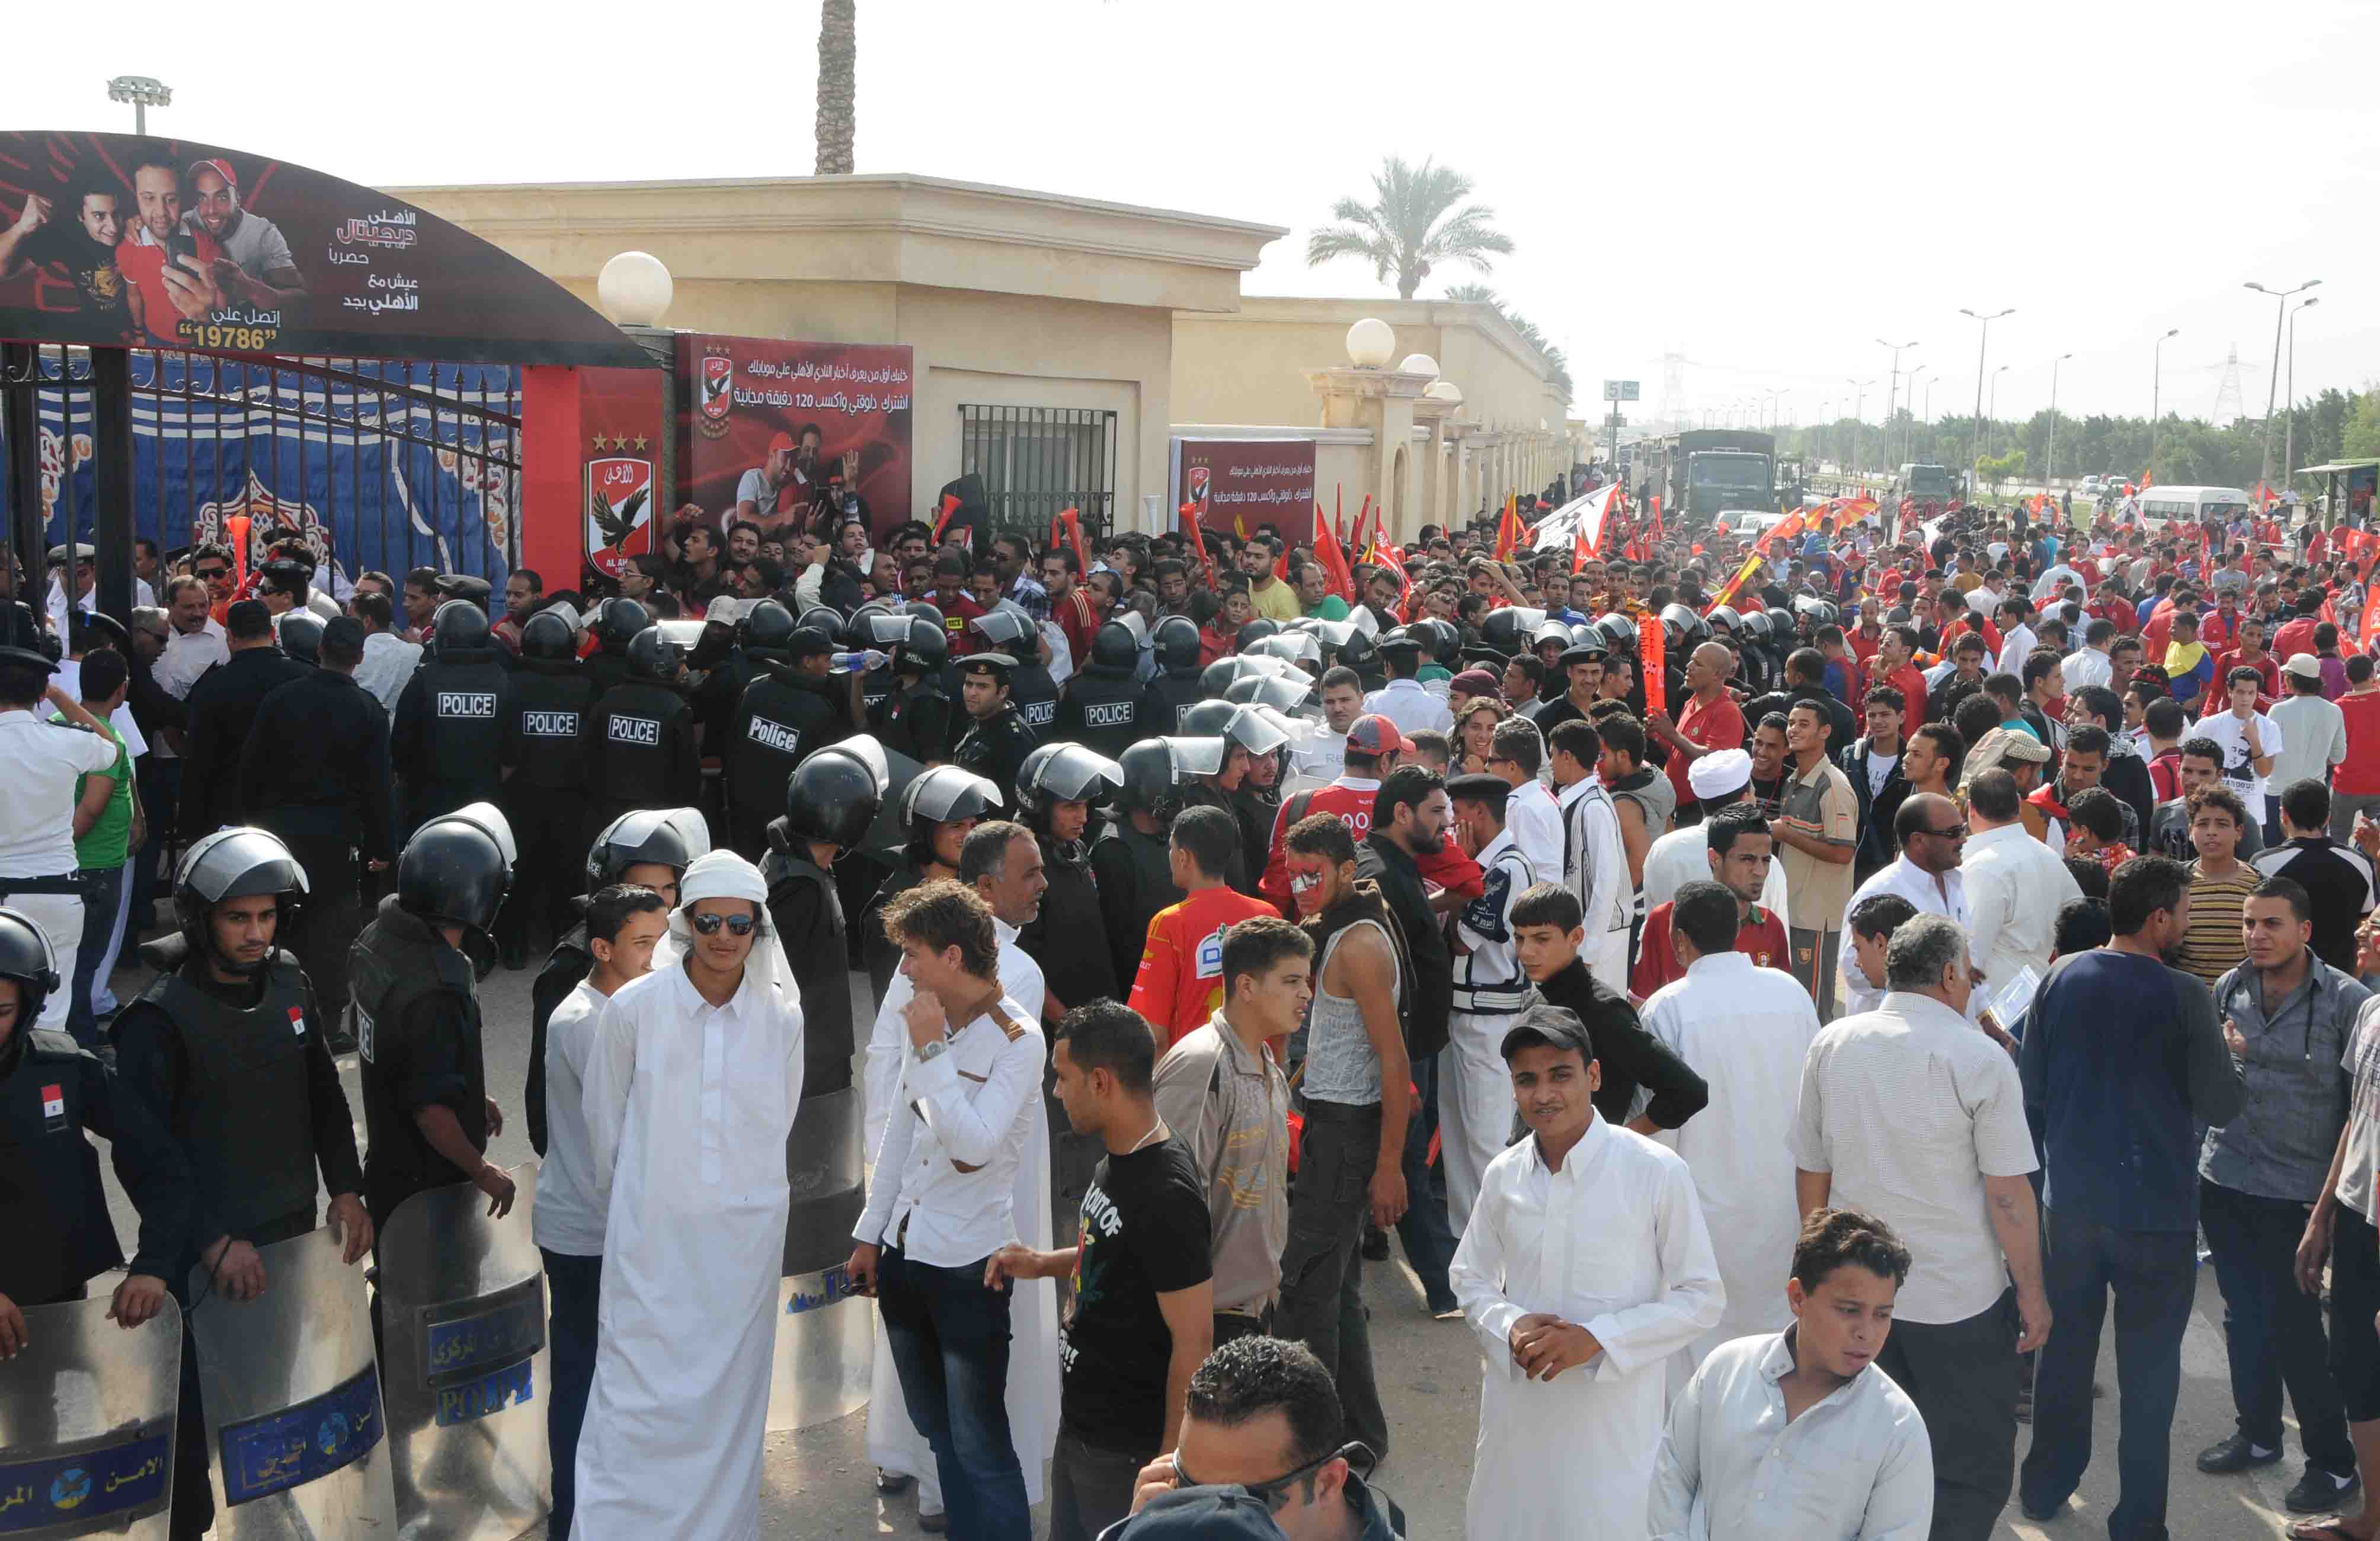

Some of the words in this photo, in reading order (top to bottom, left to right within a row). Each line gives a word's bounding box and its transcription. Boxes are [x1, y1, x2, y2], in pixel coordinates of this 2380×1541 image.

[368, 274, 385, 288] مع
[388, 273, 418, 290] عيش
[343, 296, 367, 311] بجد
[796, 394, 814, 408] 120
[443, 695, 492, 715] POLICE
[1028, 703, 1054, 723] POLICE
[1089, 705, 1130, 724] POLICE
[527, 714, 574, 733] POLICE
[611, 718, 655, 741] POLICE
[749, 717, 796, 751] Police
[1085, 1185, 1111, 1219] OUT
[1099, 1206, 1123, 1238] OF
